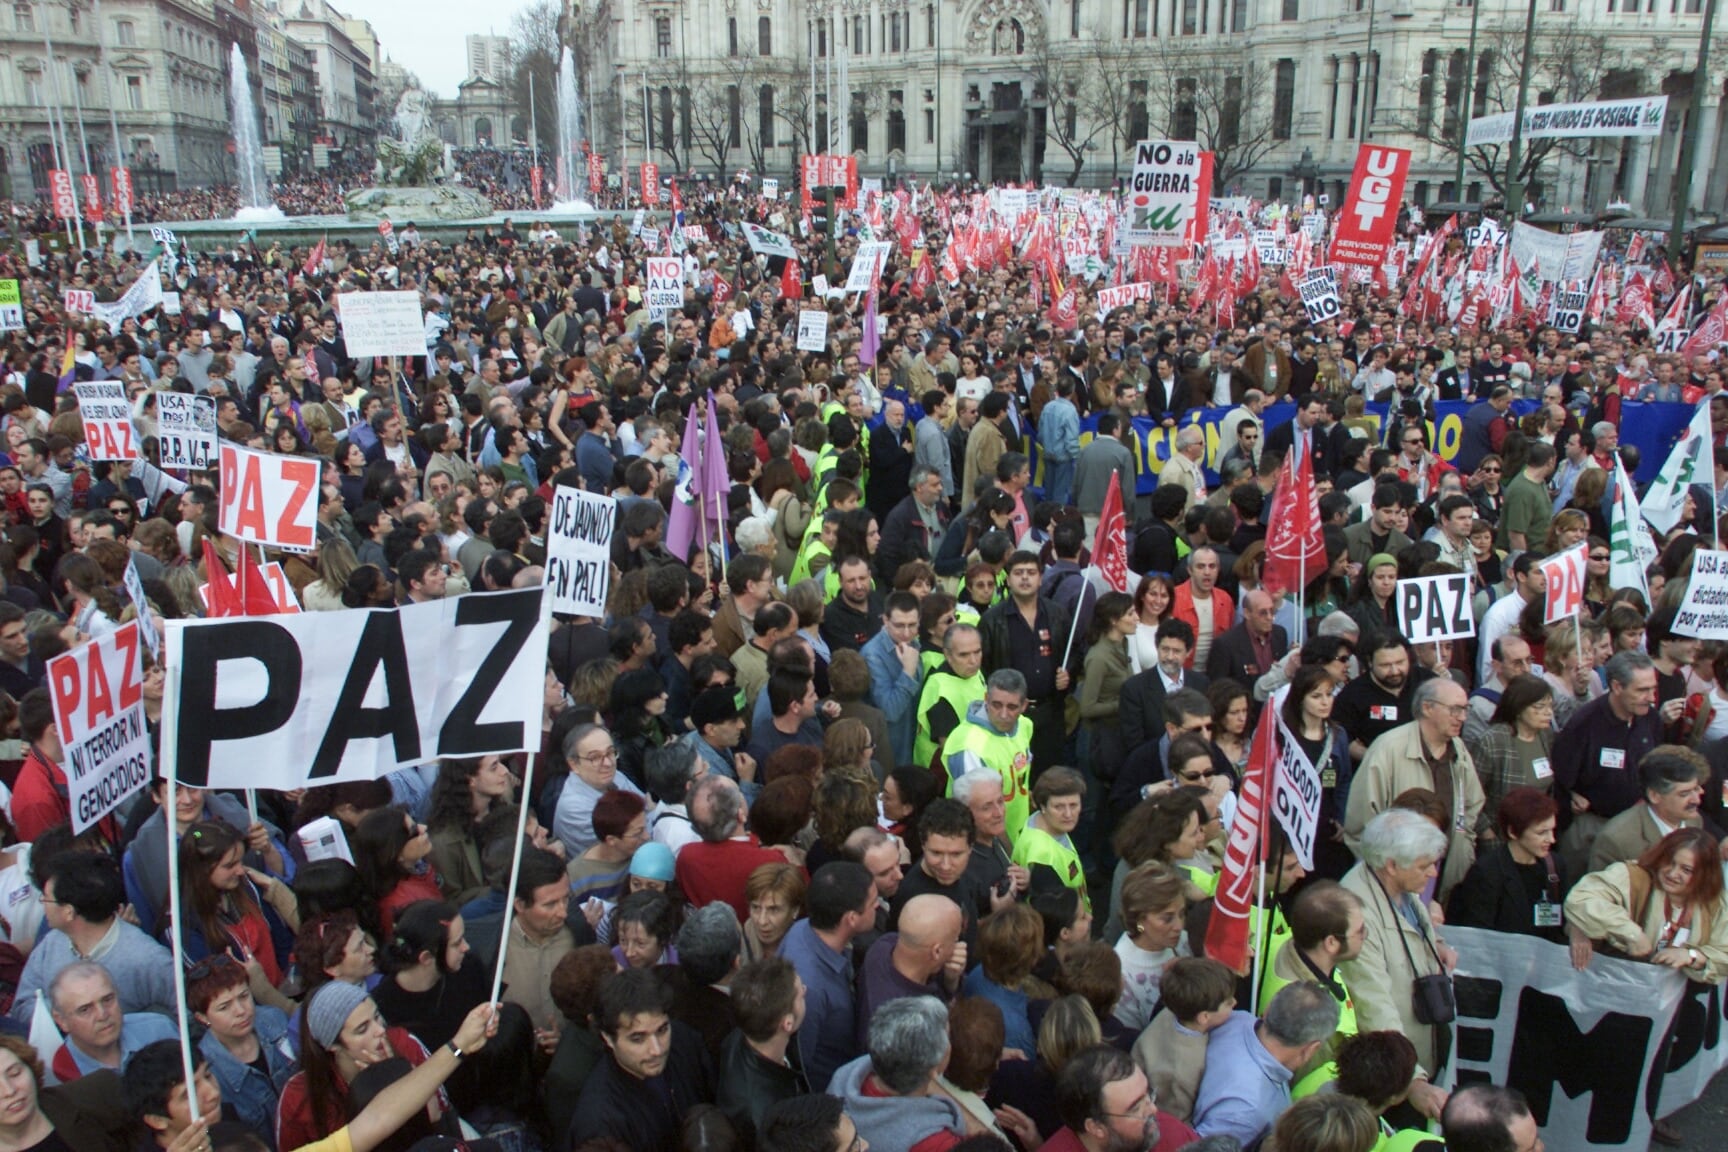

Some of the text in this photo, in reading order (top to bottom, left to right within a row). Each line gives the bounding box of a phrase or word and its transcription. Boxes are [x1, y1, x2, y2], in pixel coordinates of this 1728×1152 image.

[1531, 113, 1551, 131] OTRO
[1550, 110, 1583, 130] MUNDO
[1581, 108, 1594, 129] ES
[1594, 105, 1642, 129] POSIBLE
[1138, 145, 1172, 165] NO
[644, 165, 656, 197] CCOO
[1134, 172, 1190, 193] GUERRA
[1354, 149, 1398, 232] UGT
[1337, 239, 1384, 251] SERVICIOS
[1469, 228, 1507, 247] PAZ
[1264, 249, 1284, 263] PAZ
[651, 261, 680, 278] NO
[651, 278, 680, 290] A LA
[67, 291, 94, 312] PAZ
[651, 293, 680, 306] GUERRA
[1308, 297, 1339, 322] NO
[1556, 311, 1579, 329] NO
[85, 422, 137, 460] PAZ
[219, 446, 319, 547] PAZ
[554, 492, 614, 547] DEJADNOS
[1697, 555, 1718, 574] USA
[547, 556, 606, 607] EN PAZ!
[1403, 577, 1471, 640] PAZ
[1675, 611, 1698, 629] por
[51, 622, 142, 745] PAZ
[175, 588, 544, 788] PAZ
[70, 709, 142, 780] NI TERROR NI
[78, 752, 147, 825] GENOCIDIOS
[1284, 745, 1319, 814] BLOODY
[1276, 786, 1310, 857] OIL!
